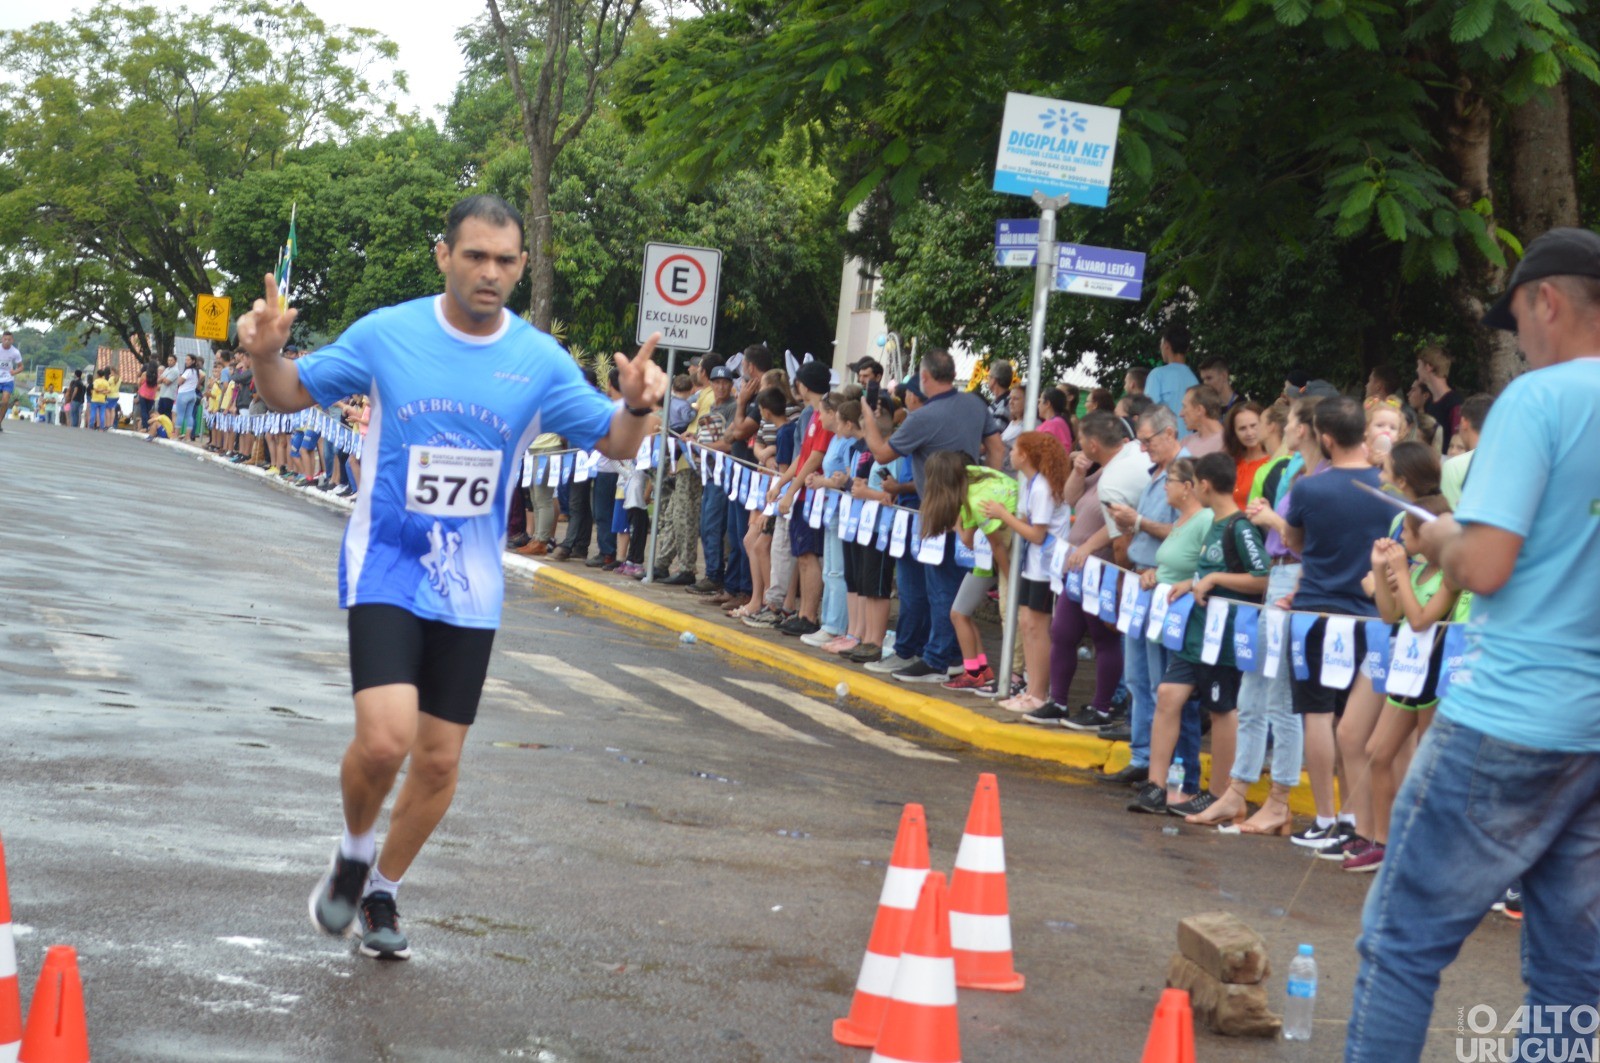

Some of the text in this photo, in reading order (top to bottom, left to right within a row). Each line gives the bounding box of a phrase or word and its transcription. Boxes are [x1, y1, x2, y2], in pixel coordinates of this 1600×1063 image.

[1008, 130, 1110, 160] DIGIPLAN NET
[1073, 156, 1104, 167] INTERNET
[1060, 246, 1077, 256] RUA
[1059, 256, 1136, 278] DR. ÁLVARO LEITÃO
[671, 266, 690, 294] E
[645, 310, 708, 326] EXCLUSIVO
[663, 325, 688, 339] TÁXI
[397, 398, 512, 440] QUEBRA VENTO
[415, 474, 490, 506] 576
[1242, 528, 1264, 570] HAVAN
[1392, 659, 1426, 675] Banrisul
